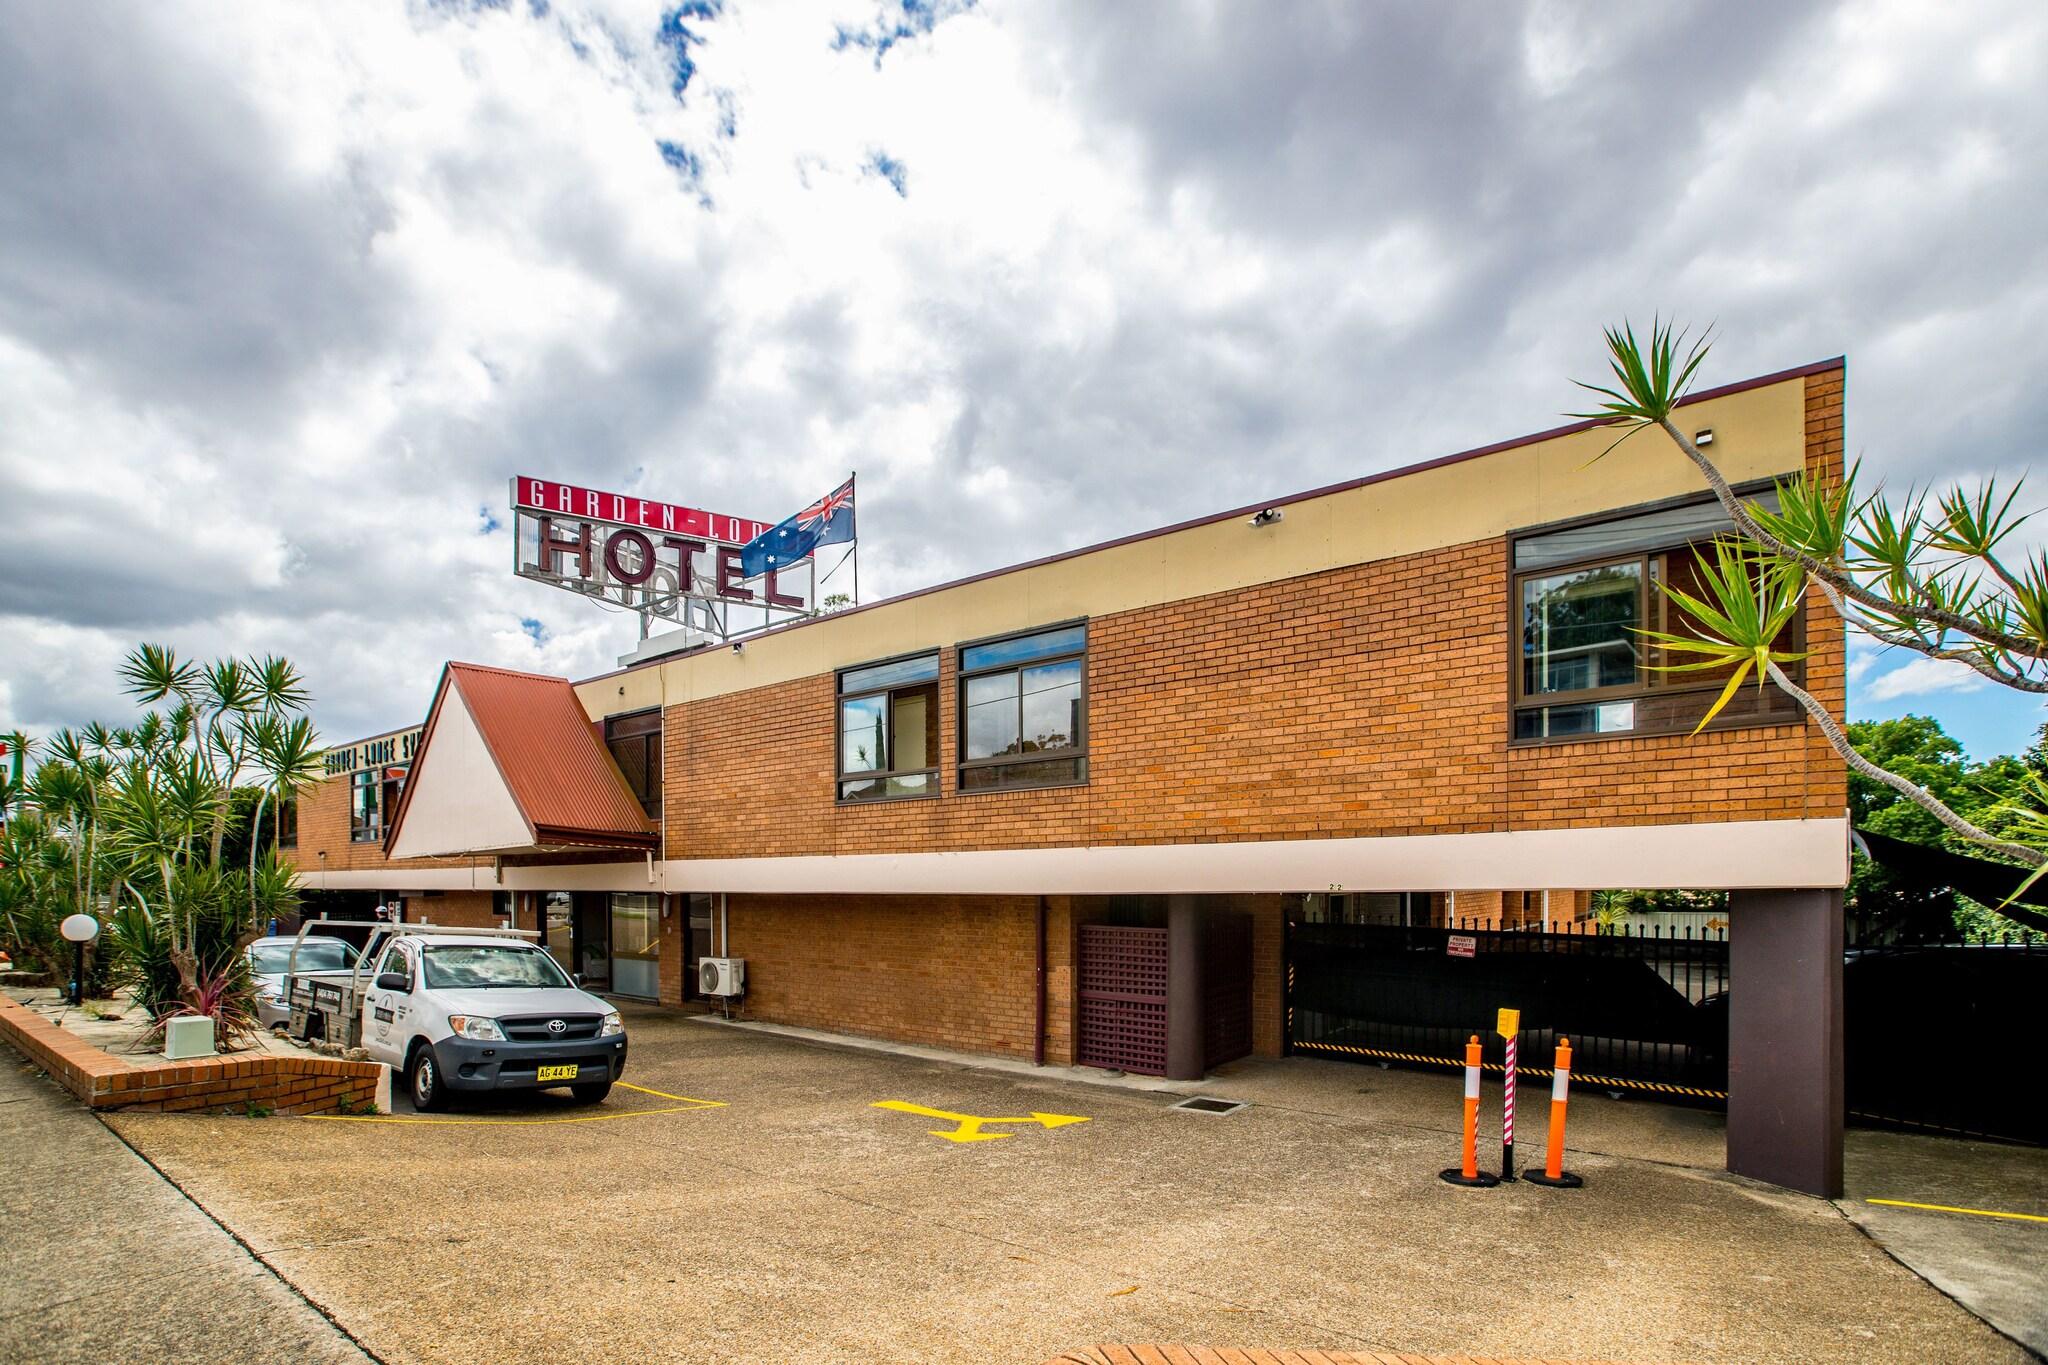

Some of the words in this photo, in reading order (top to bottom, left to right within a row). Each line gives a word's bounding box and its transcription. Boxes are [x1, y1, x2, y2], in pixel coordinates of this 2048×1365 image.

[531, 480, 763, 542] GARDEN-LOD
[538, 515, 805, 608] HOTEL
[540, 1067, 551, 1078] AG
[552, 1067, 564, 1077] 44
[566, 1066, 578, 1076] YE
